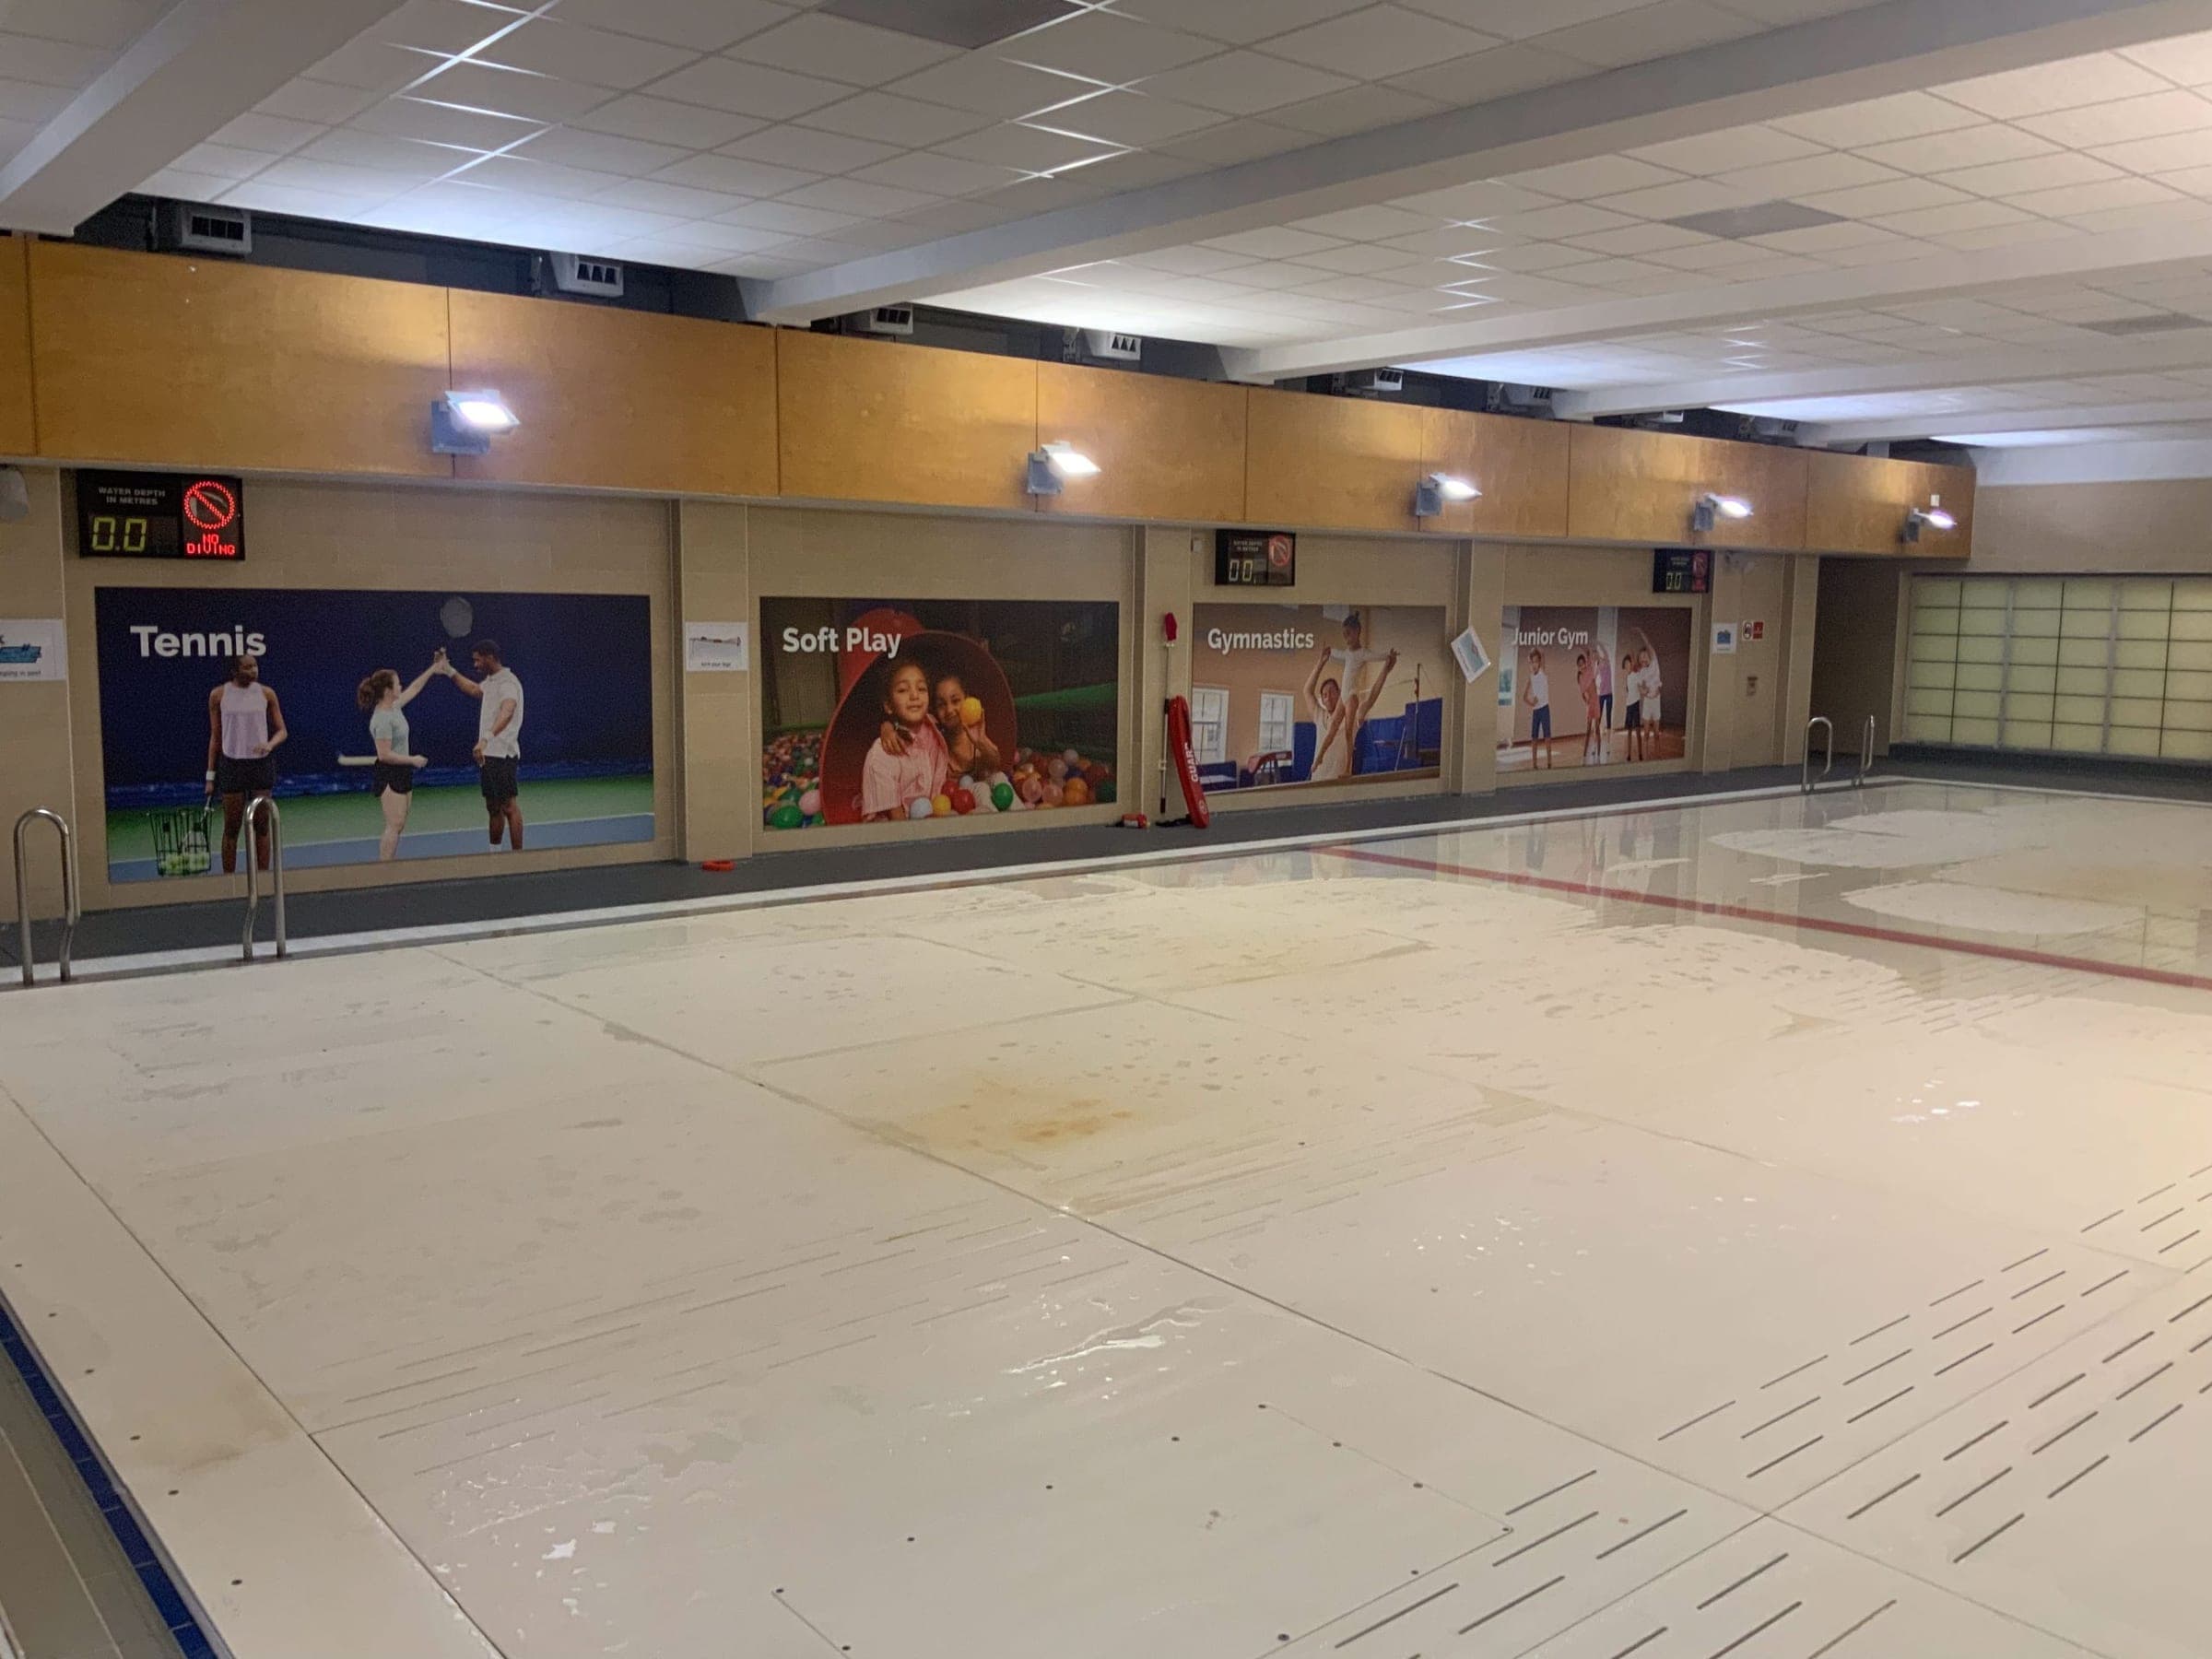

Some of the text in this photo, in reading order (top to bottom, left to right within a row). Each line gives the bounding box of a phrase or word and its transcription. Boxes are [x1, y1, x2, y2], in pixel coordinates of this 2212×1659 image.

[98, 486, 166, 498] WATER DEPTH
[106, 496, 159, 505] IN METRES
[202, 534, 219, 544] NO
[186, 542, 236, 556] DIVING
[129, 625, 267, 657] Tennis
[782, 626, 901, 659] Soft Play
[1207, 628, 1314, 655] Gymnastics
[1512, 627, 1589, 650] Junior Gym
